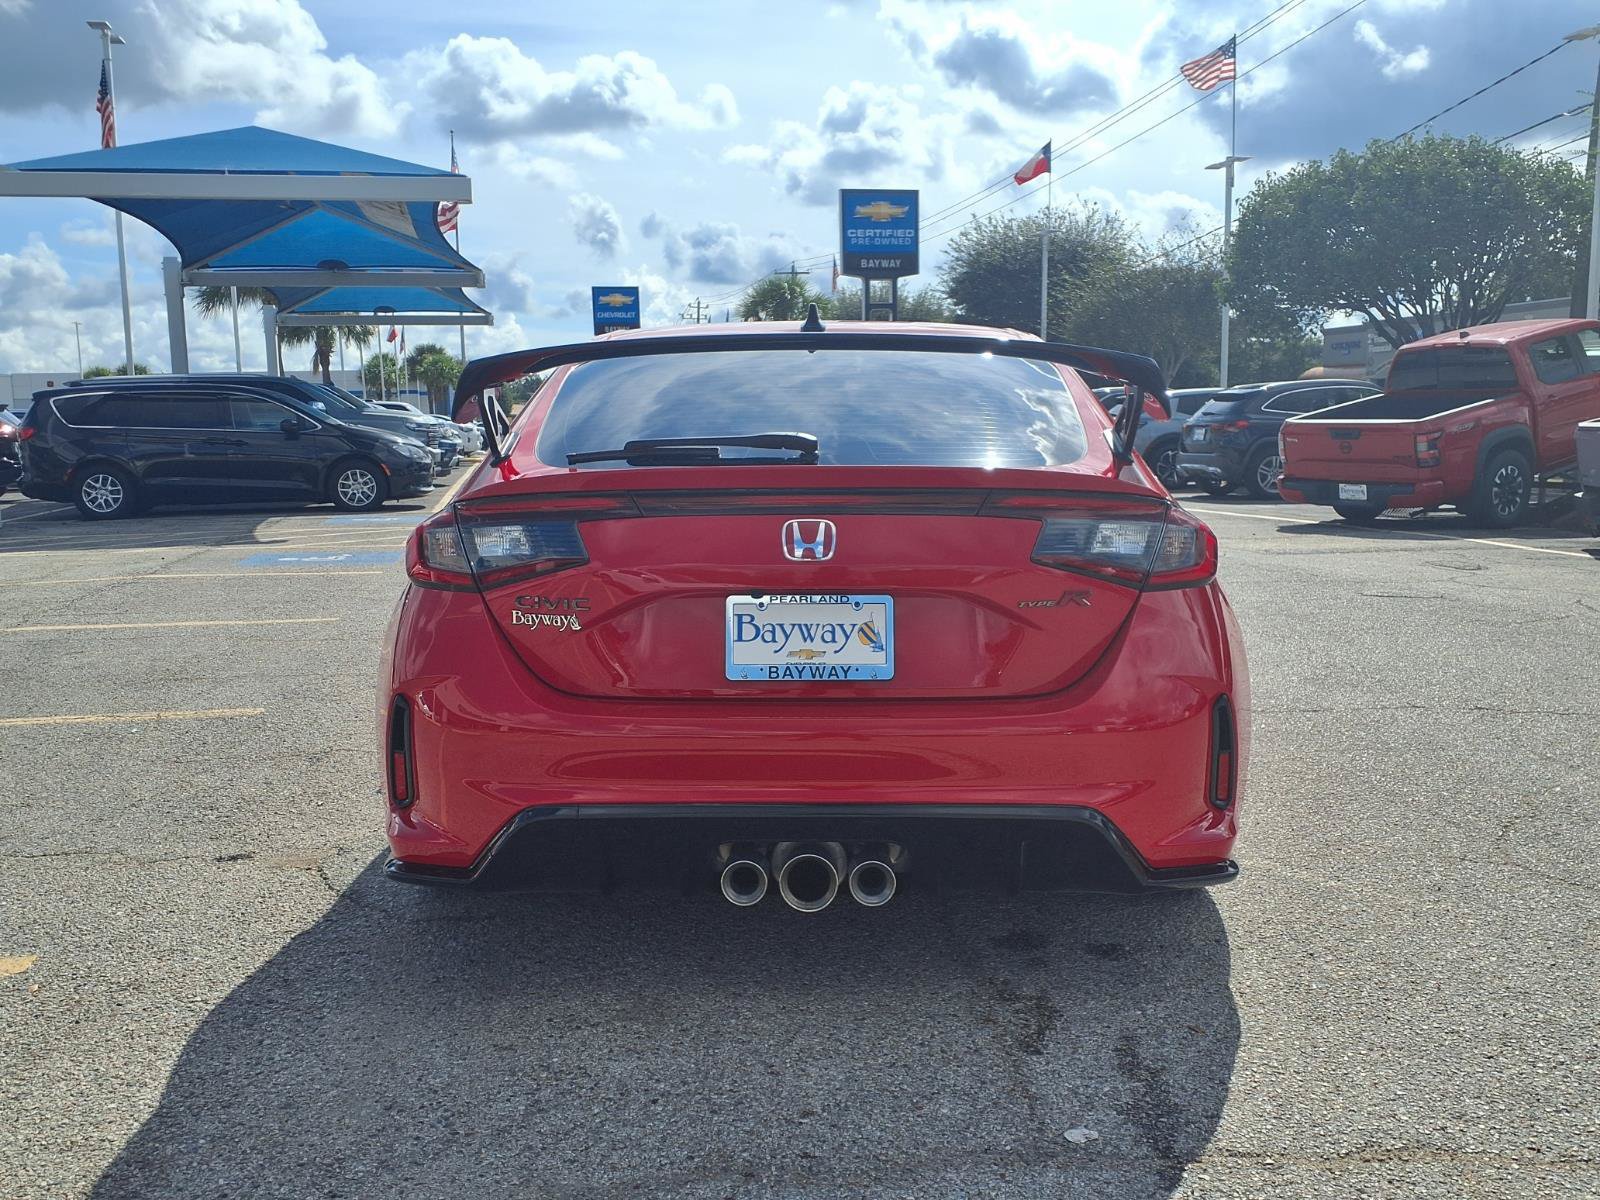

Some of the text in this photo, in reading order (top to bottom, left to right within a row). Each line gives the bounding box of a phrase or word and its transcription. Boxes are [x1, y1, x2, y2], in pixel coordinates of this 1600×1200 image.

[847, 229, 915, 238] CERTIFIED
[850, 237, 912, 245] PRE-OWNED
[860, 259, 901, 268] BAYWAY
[515, 595, 591, 611] CIVIC
[769, 595, 850, 604] PEARLAND
[1017, 588, 1094, 608] TYPE R
[512, 610, 571, 632] Bayway
[733, 613, 858, 654] Bayway
[768, 665, 852, 680] BAYWAY
